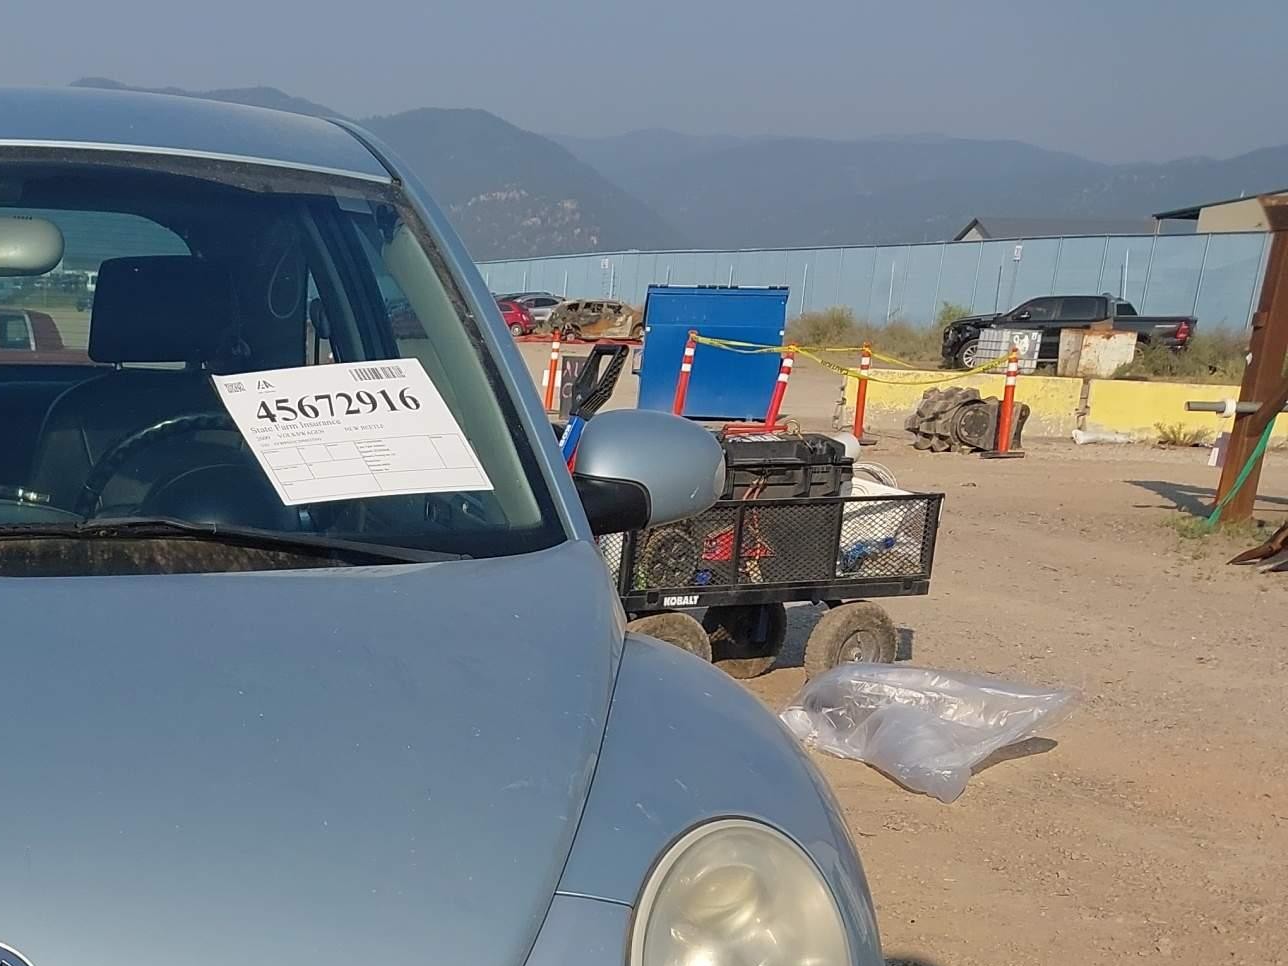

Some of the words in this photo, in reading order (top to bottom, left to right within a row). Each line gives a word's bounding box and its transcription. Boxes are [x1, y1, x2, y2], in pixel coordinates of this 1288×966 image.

[256, 387, 421, 423] 45672916
[250, 425, 273, 434] State
[274, 422, 299, 431] Farm
[300, 418, 341, 429] Insurance
[663, 595, 699, 607] KOBALT
